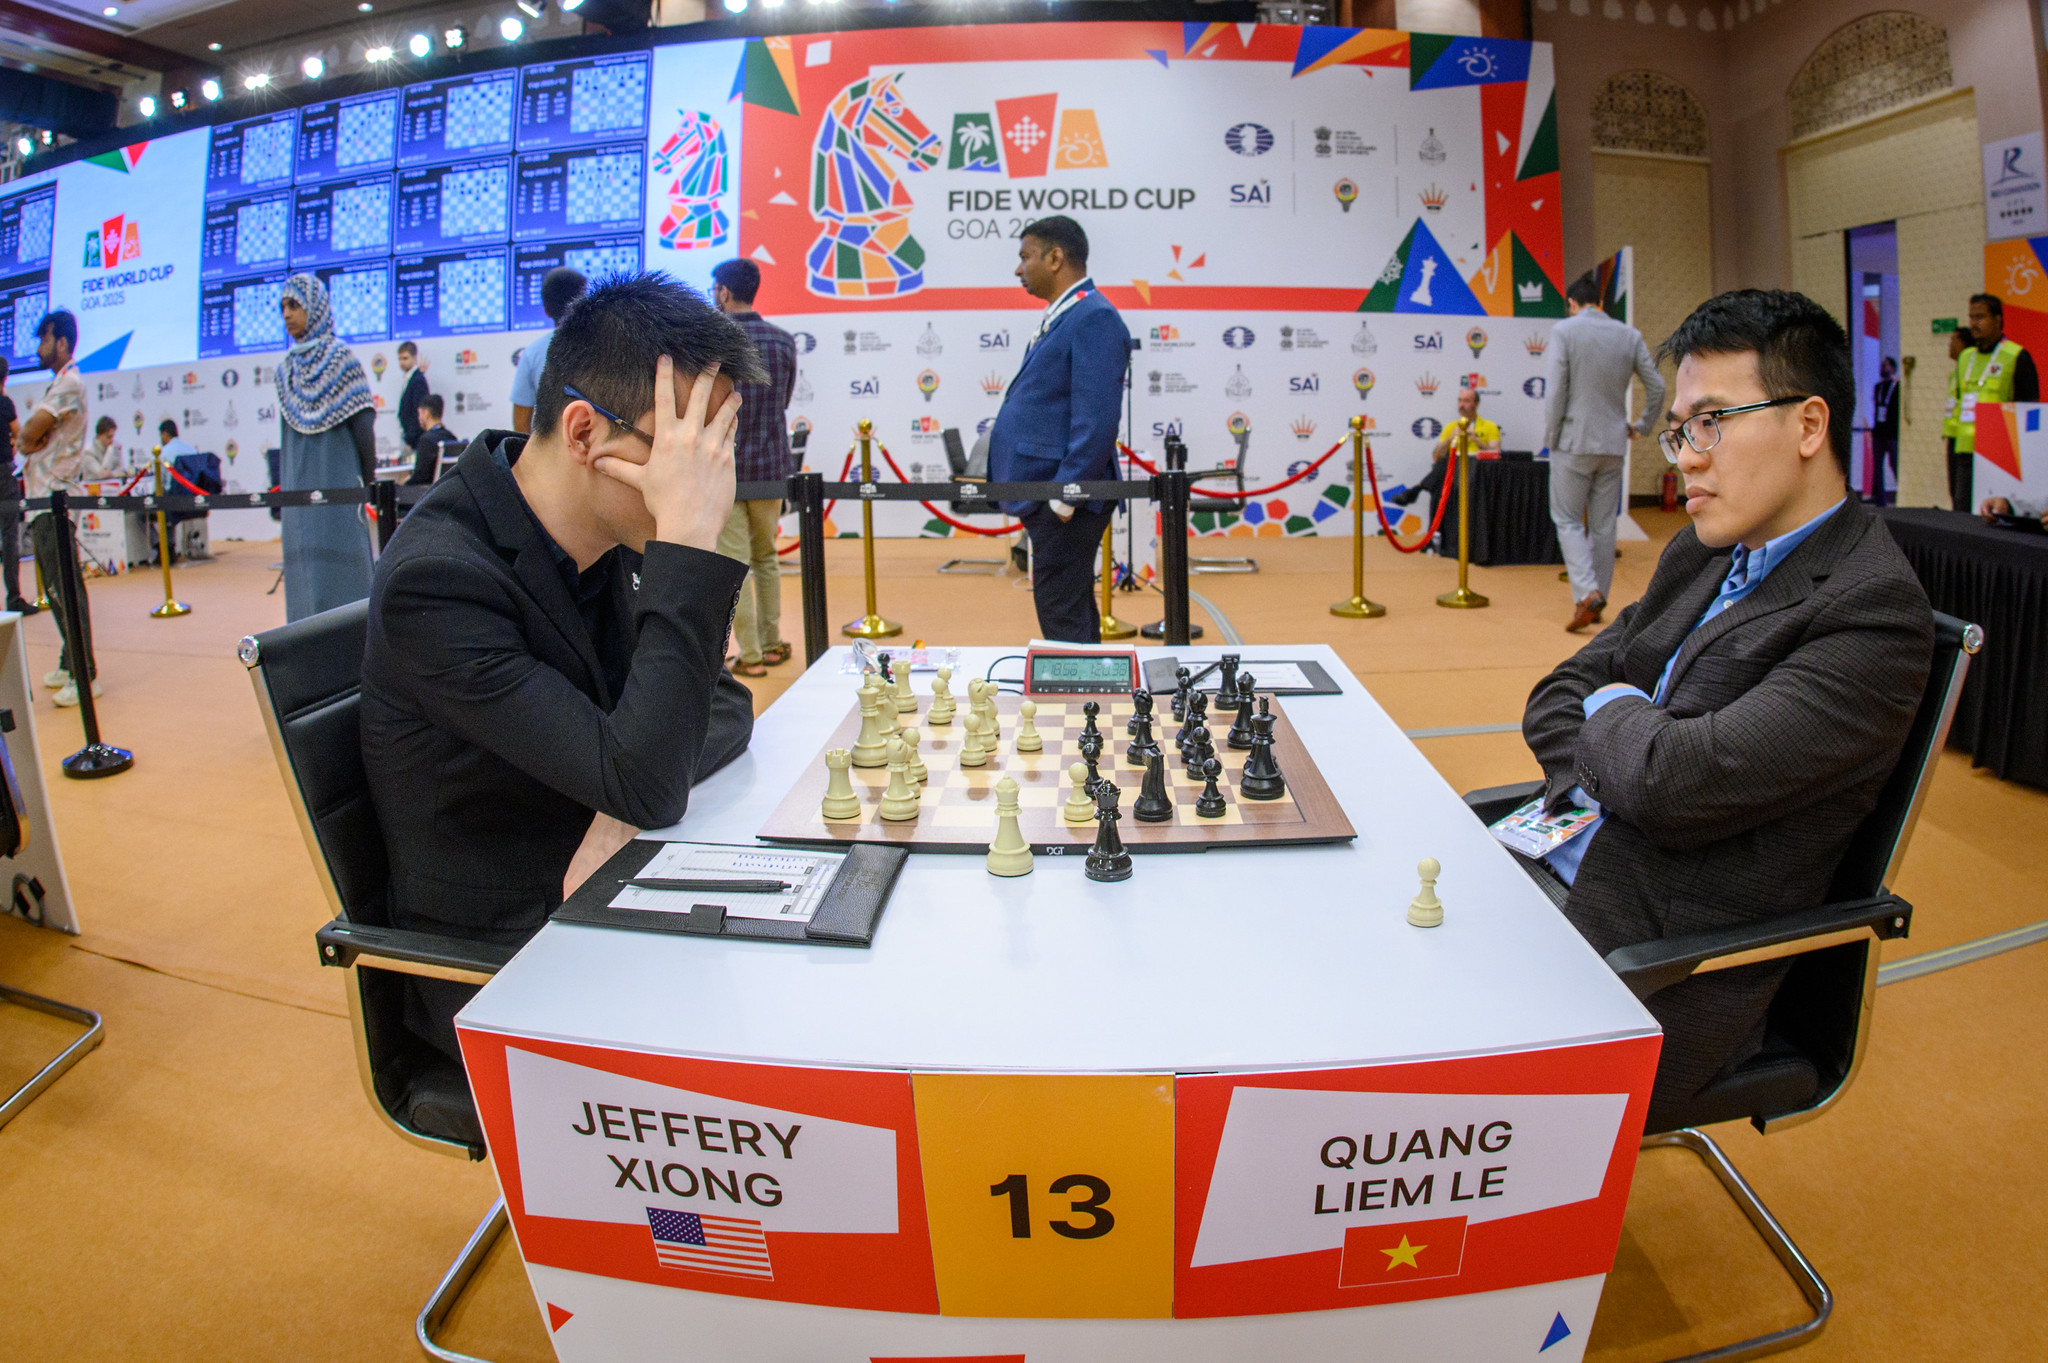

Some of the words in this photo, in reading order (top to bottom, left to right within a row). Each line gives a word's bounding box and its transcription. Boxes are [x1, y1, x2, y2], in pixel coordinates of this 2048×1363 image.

[948, 190, 1011, 212] FIDE
[1018, 189, 1128, 210] WORLD
[1134, 188, 1195, 210] CUP
[1230, 184, 1270, 203] SAI
[947, 218, 1001, 240] GOA
[82, 277, 104, 294] FIDE
[106, 269, 148, 289] WORLD
[149, 264, 174, 282] CUP
[81, 296, 100, 311] GOA
[102, 290, 125, 307] 2025
[1046, 846, 1065, 856] DGT
[572, 1101, 802, 1159] JEFFERY
[1320, 1120, 1513, 1170] QUANG
[606, 1154, 783, 1207] XIONG
[1314, 1174, 1434, 1214] LIEM
[1450, 1166, 1508, 1201] LE
[990, 1174, 1115, 1239] 13
